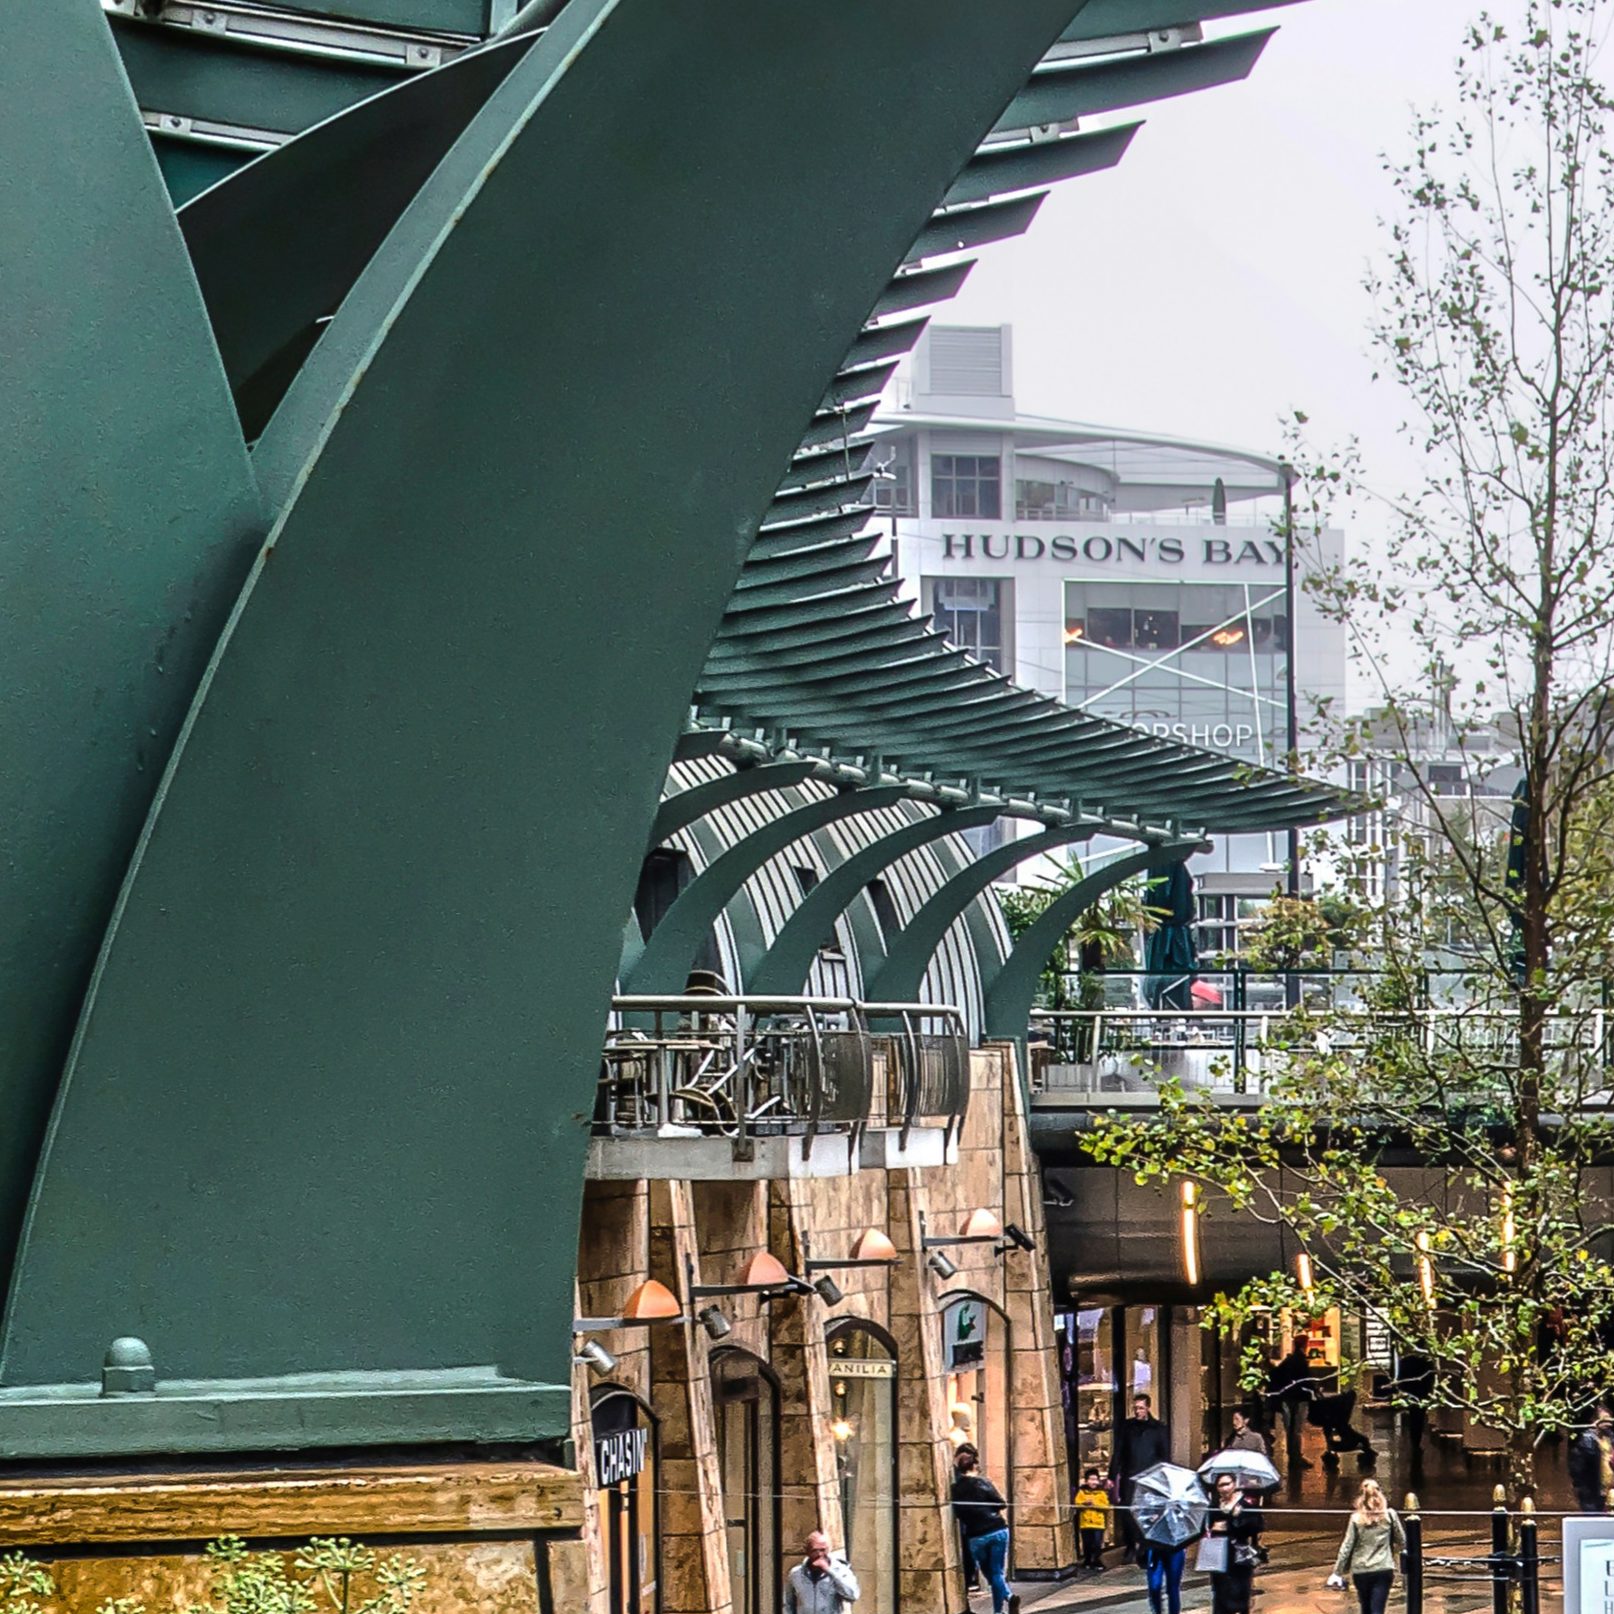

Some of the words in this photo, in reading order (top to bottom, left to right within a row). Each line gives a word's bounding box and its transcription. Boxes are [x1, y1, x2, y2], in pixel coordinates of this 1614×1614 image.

[943, 533, 1185, 563] HUDSON'S
[1202, 539, 1287, 565] BAY
[828, 1362, 887, 1375] ANILIA
